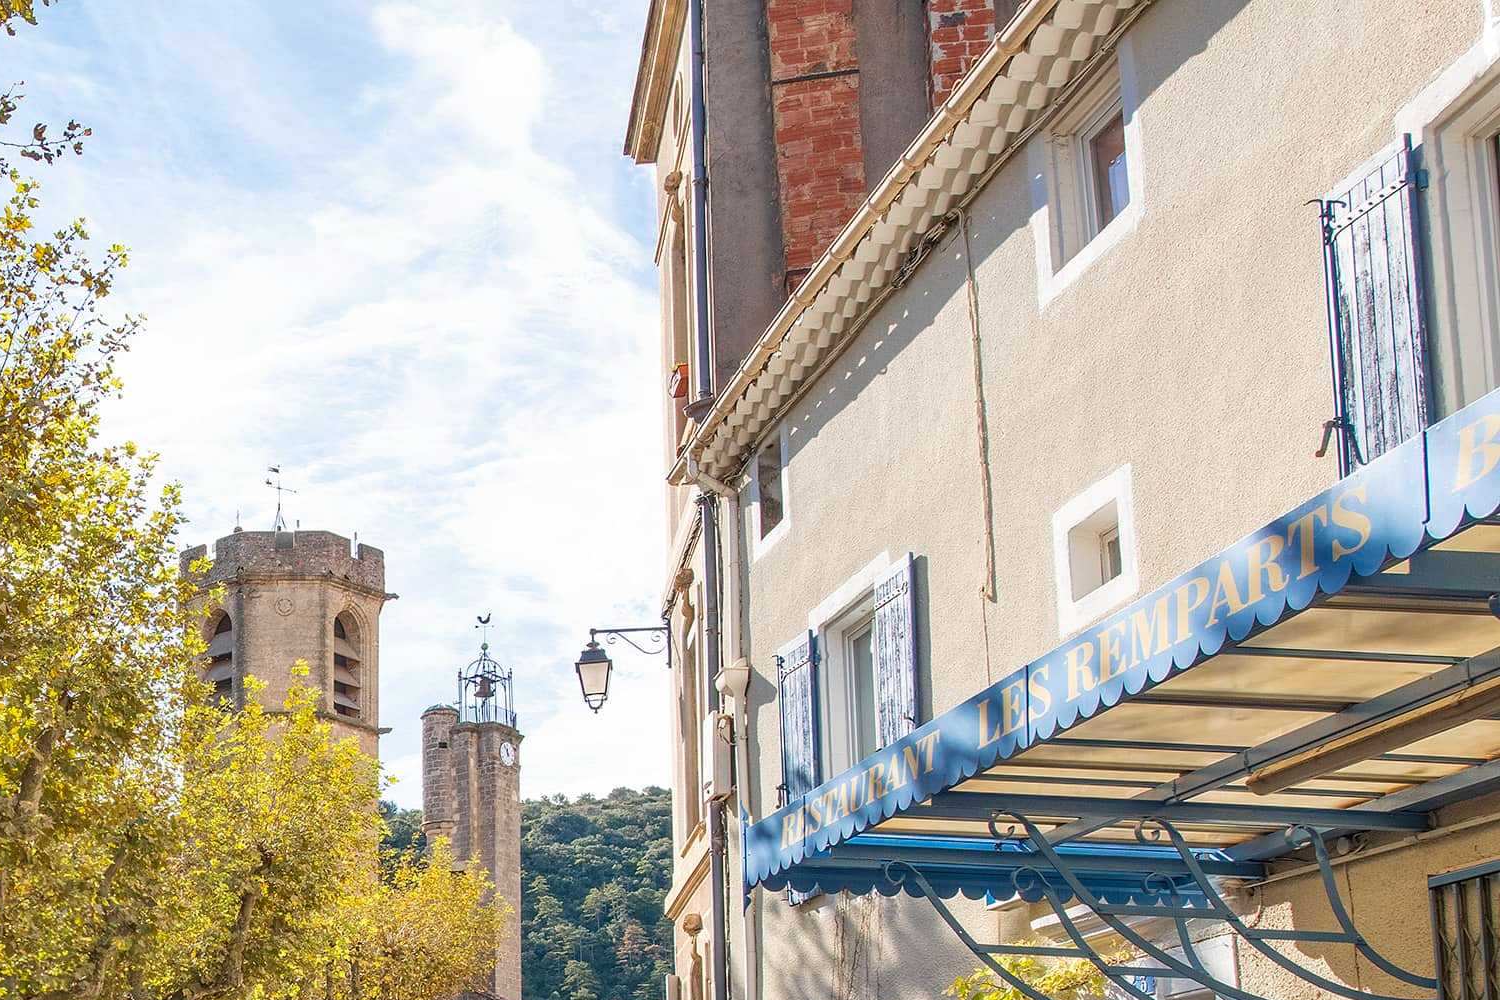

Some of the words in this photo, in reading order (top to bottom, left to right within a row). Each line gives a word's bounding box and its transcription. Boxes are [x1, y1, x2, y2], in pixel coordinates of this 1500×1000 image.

[779, 729, 940, 851] RESTAURANT
[976, 663, 1052, 750] LES
[1064, 484, 1372, 703] REMPARTS
